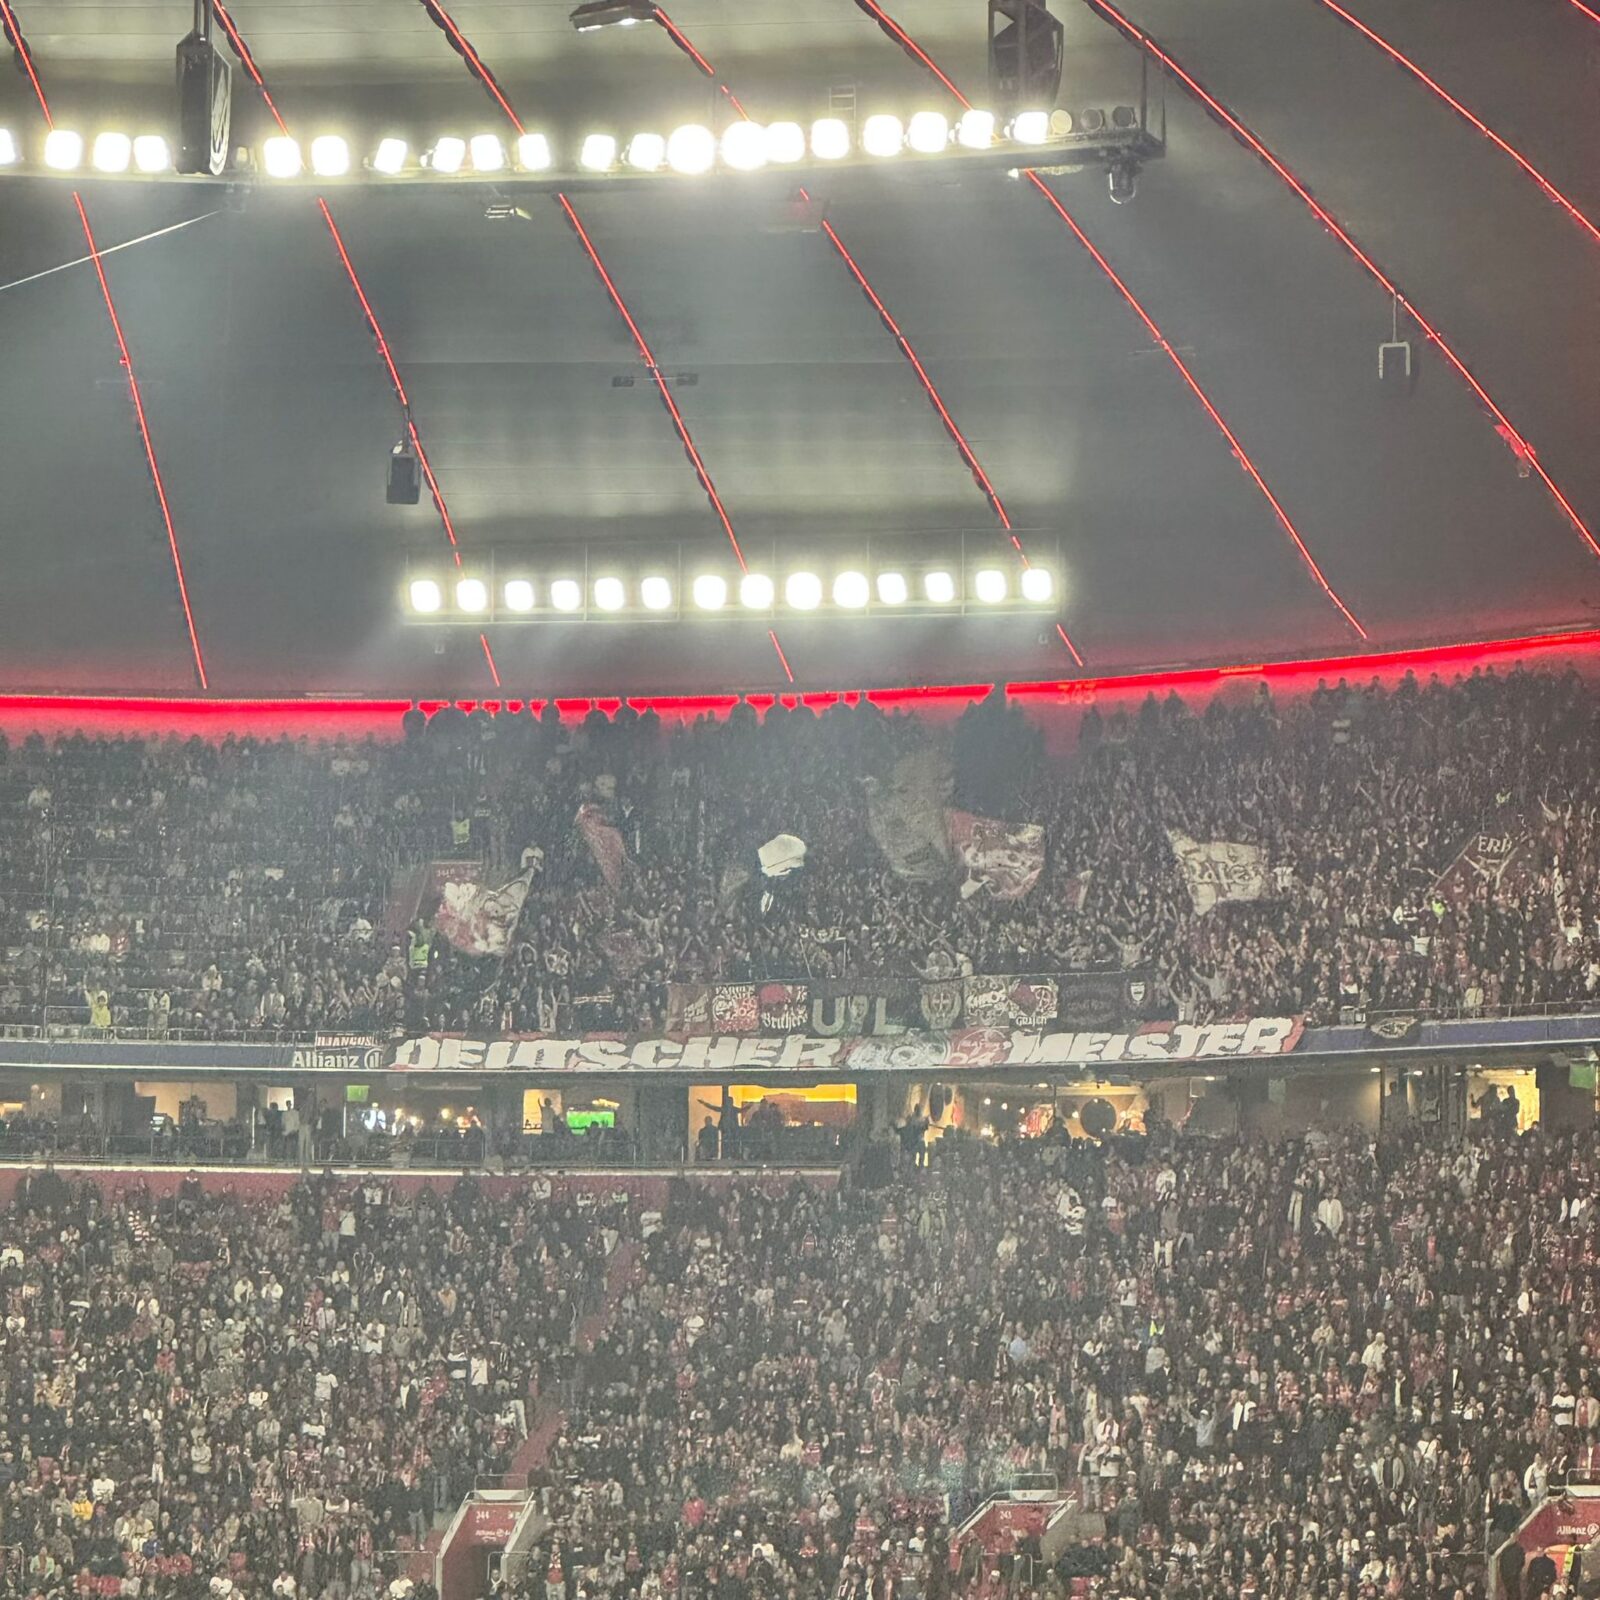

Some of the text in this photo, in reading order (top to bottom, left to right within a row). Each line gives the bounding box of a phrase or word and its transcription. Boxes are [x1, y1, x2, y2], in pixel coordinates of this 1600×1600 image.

[394, 1034, 842, 1070] DEUTSCHER
[1009, 1017, 1294, 1064] MEISTER
[292, 1051, 359, 1068] Allianz
[1556, 1525, 1587, 1535] Allianz
